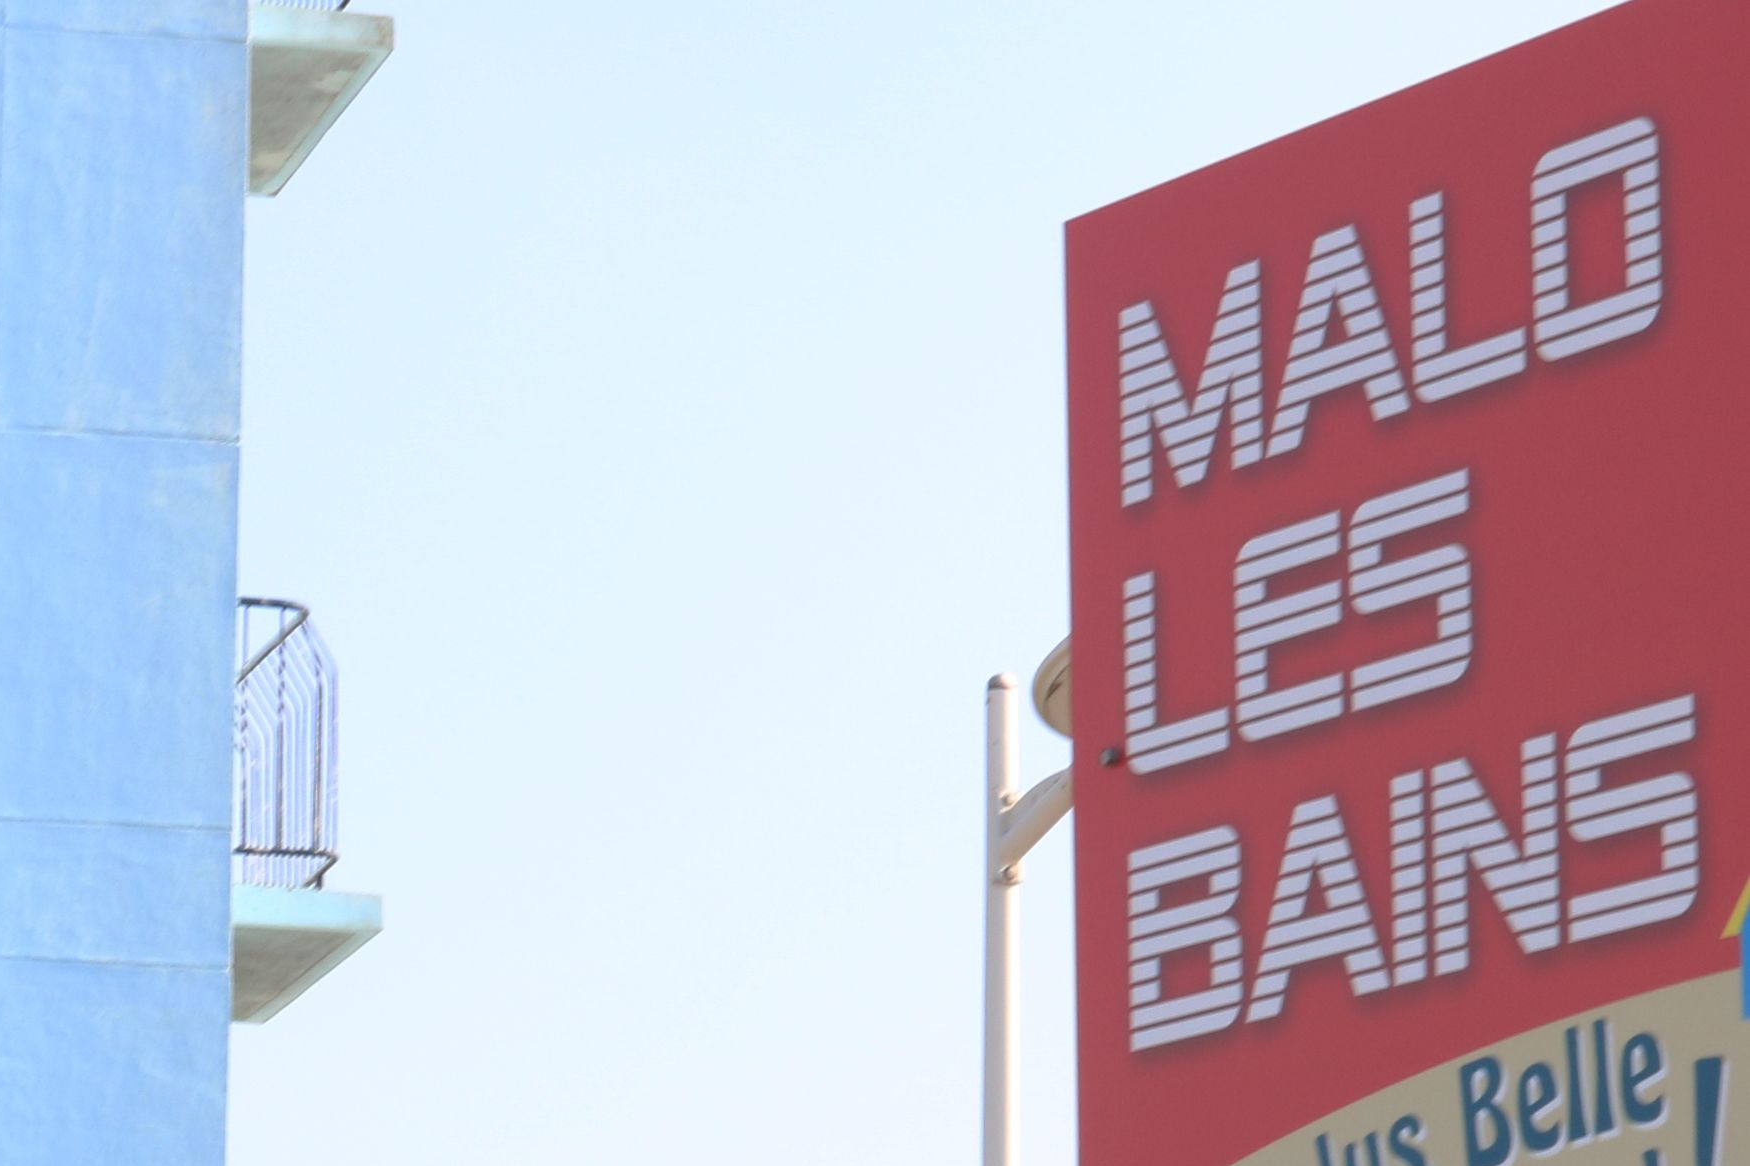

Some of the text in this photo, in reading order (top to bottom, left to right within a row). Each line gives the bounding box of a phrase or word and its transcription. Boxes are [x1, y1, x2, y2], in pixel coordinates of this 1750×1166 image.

[1117, 114, 1663, 508] MALO
[1123, 466, 1474, 776] LES
[1128, 692, 1700, 1054] BAINS
